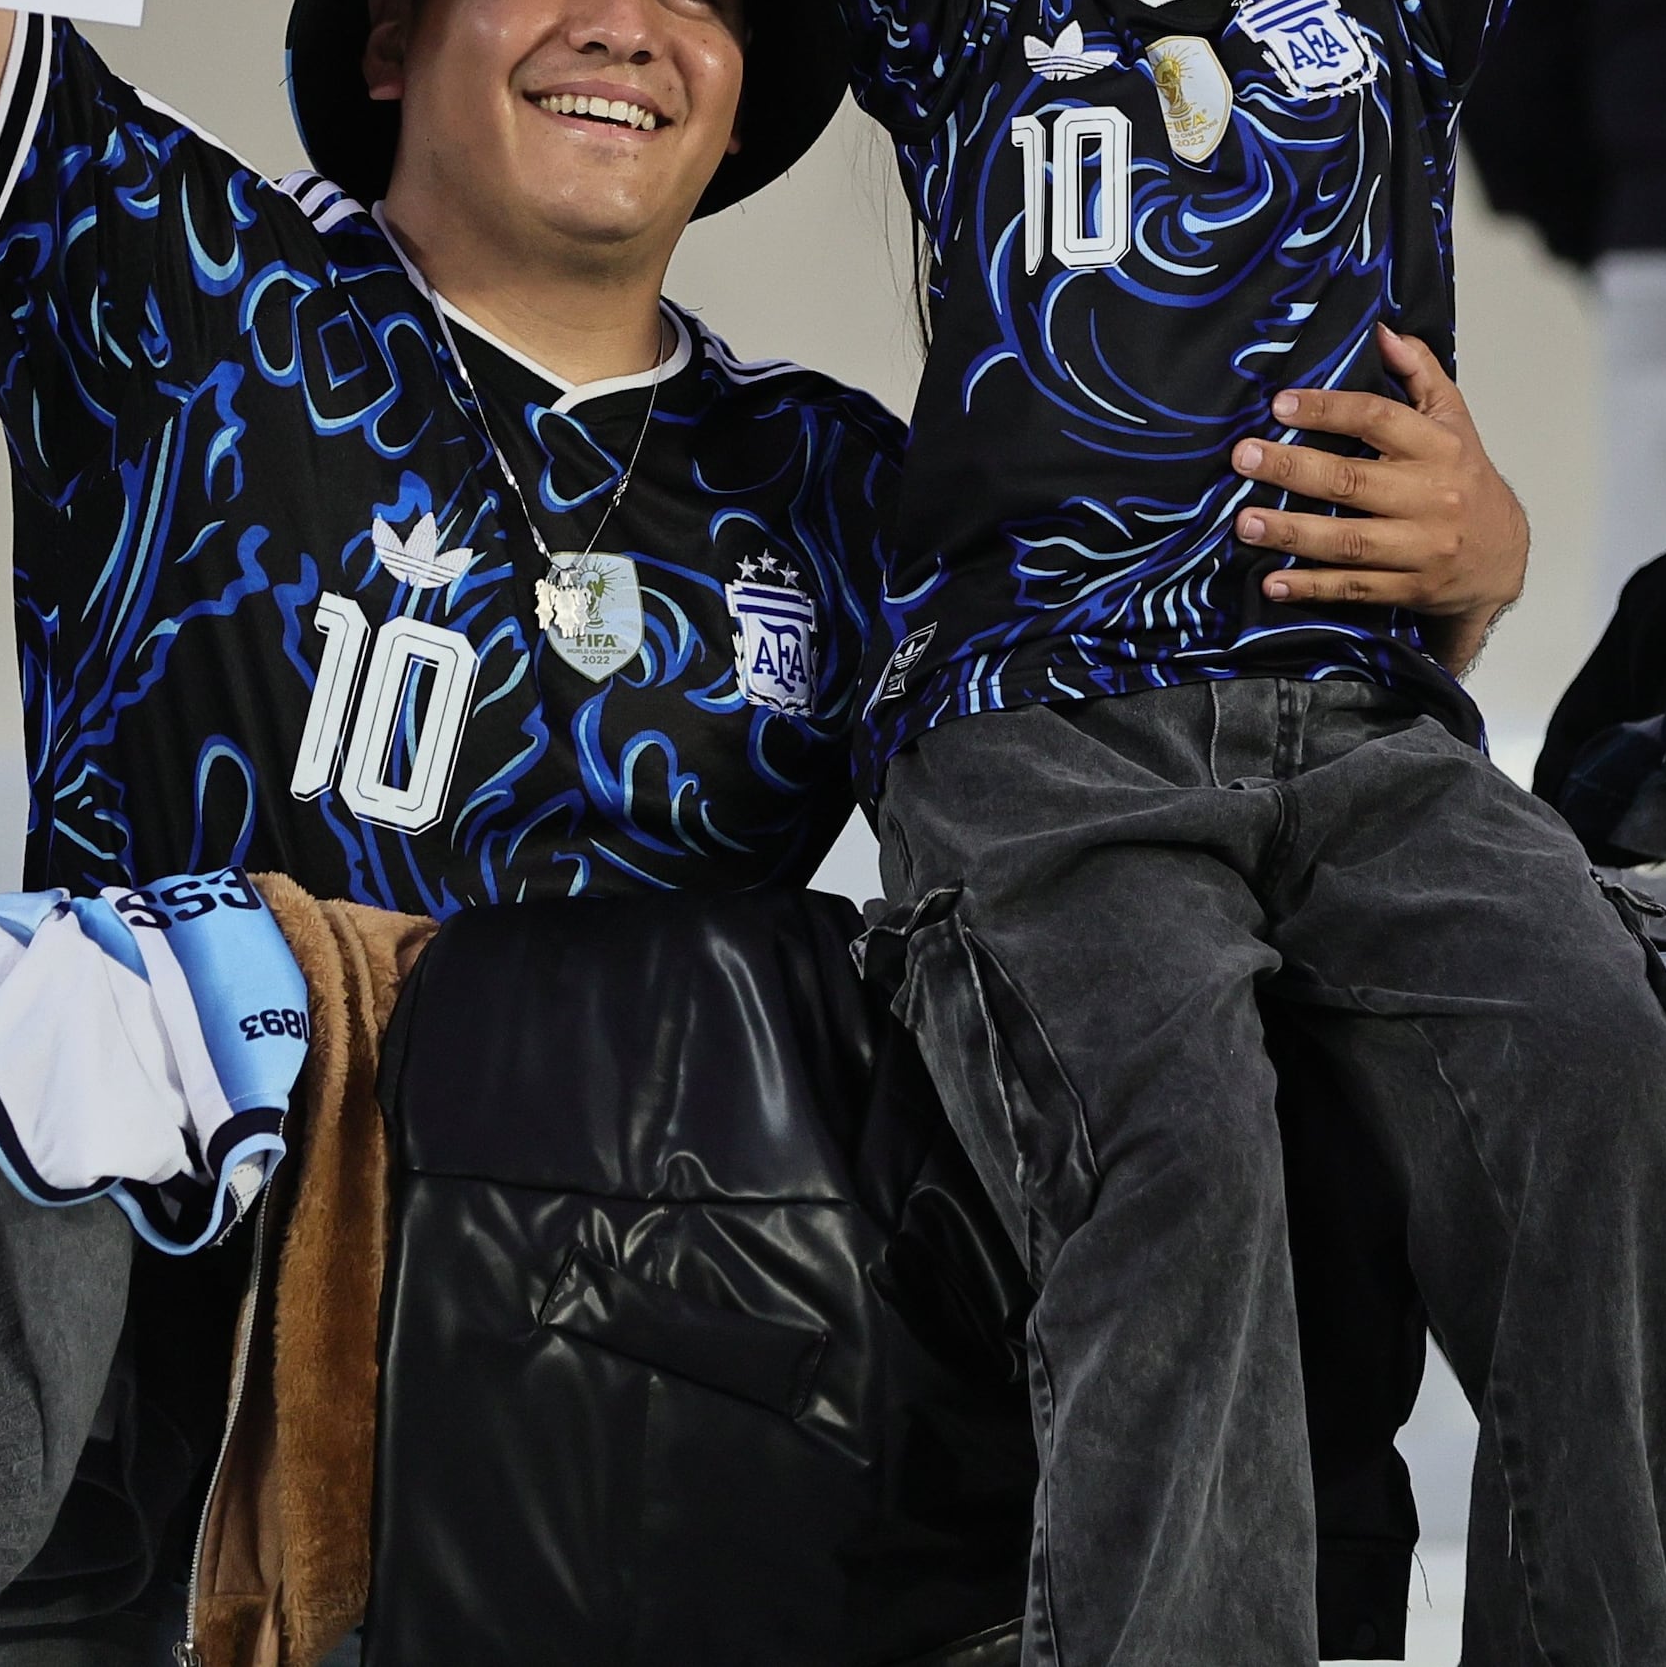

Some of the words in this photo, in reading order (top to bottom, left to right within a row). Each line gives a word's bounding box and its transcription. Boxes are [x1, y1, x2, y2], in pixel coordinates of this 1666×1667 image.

[1278, 17, 1349, 70] AFA
[1175, 135, 1205, 147] 2022
[1011, 106, 1132, 276] 10
[582, 656, 610, 664] 2022
[752, 618, 807, 693] AFA
[290, 590, 481, 835] 10
[239, 1009, 311, 1044] 1893
